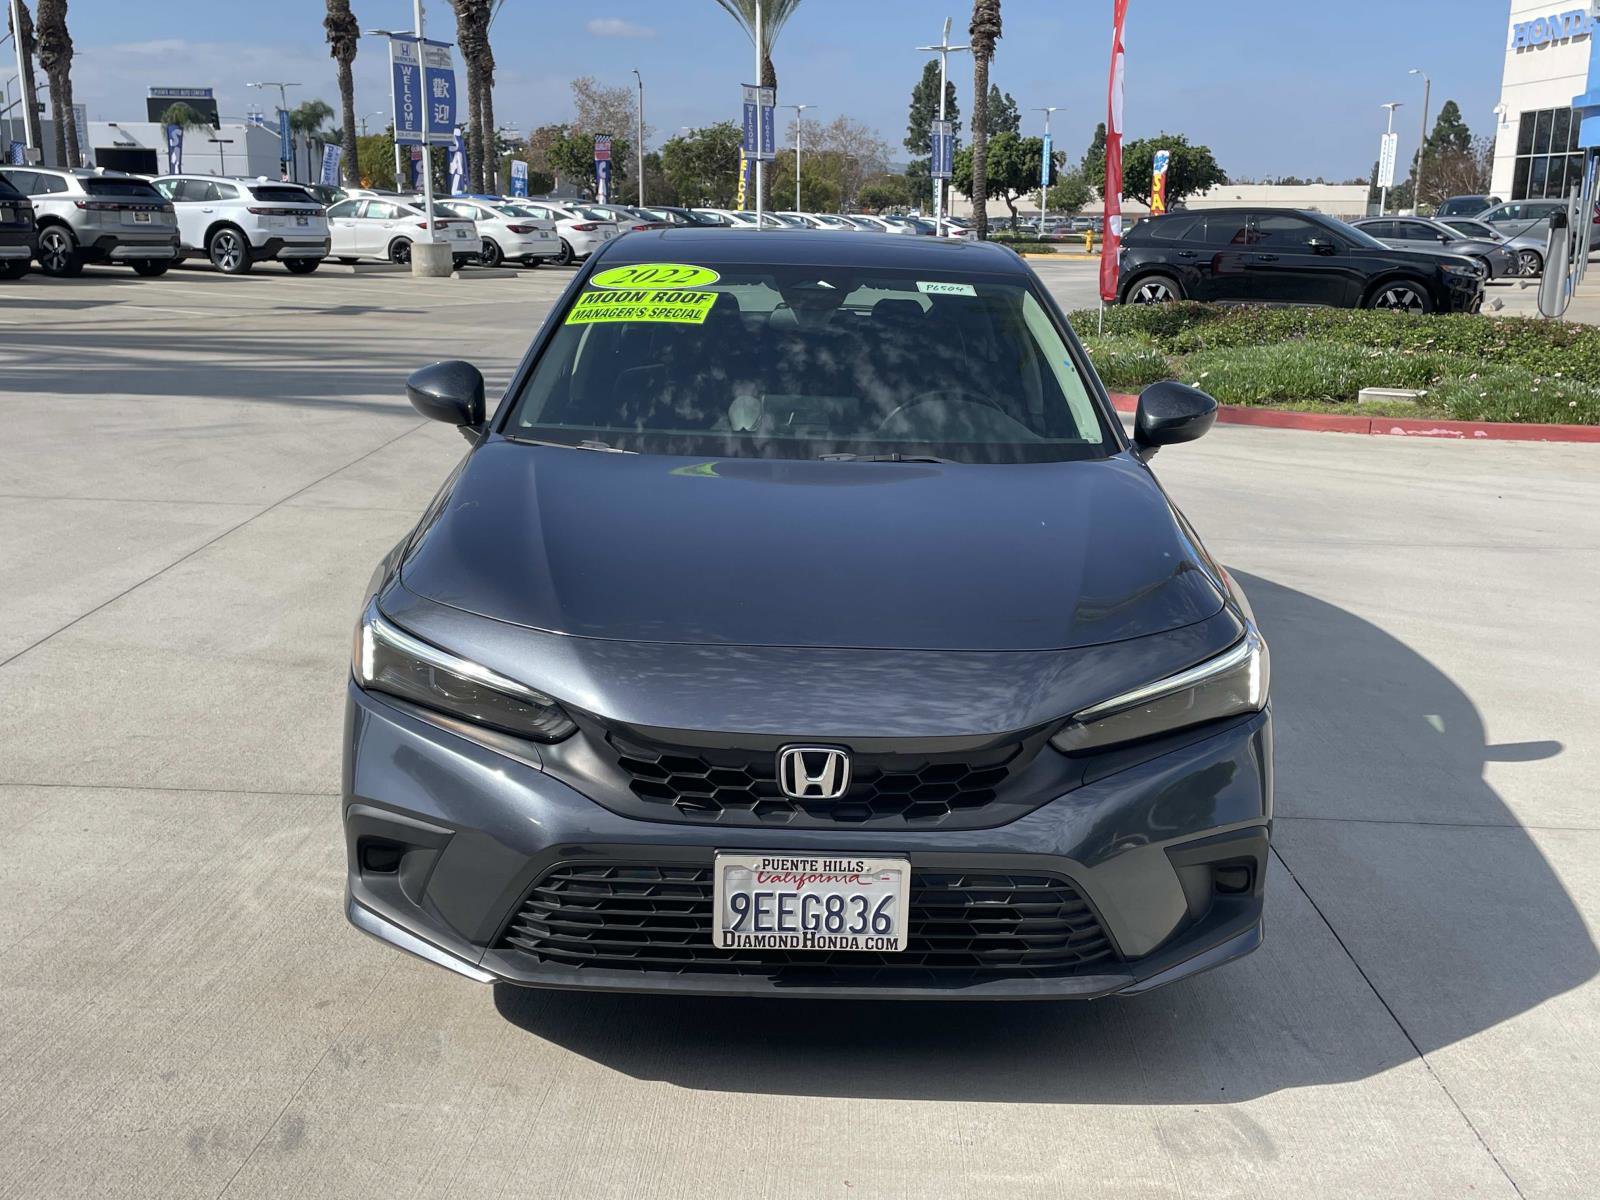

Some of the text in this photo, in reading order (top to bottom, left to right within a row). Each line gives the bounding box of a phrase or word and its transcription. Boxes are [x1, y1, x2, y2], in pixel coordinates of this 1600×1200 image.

[400, 64, 413, 130] WELCOME
[432, 77, 450, 124] 歡迎
[608, 268, 700, 284] 2022
[580, 291, 712, 305] MOON ROOF
[572, 307, 703, 321] MANAGER'S SPECIAL
[762, 858, 864, 873] PUENTE HILLS
[756, 871, 873, 890] California
[730, 892, 896, 934] 9EEG836
